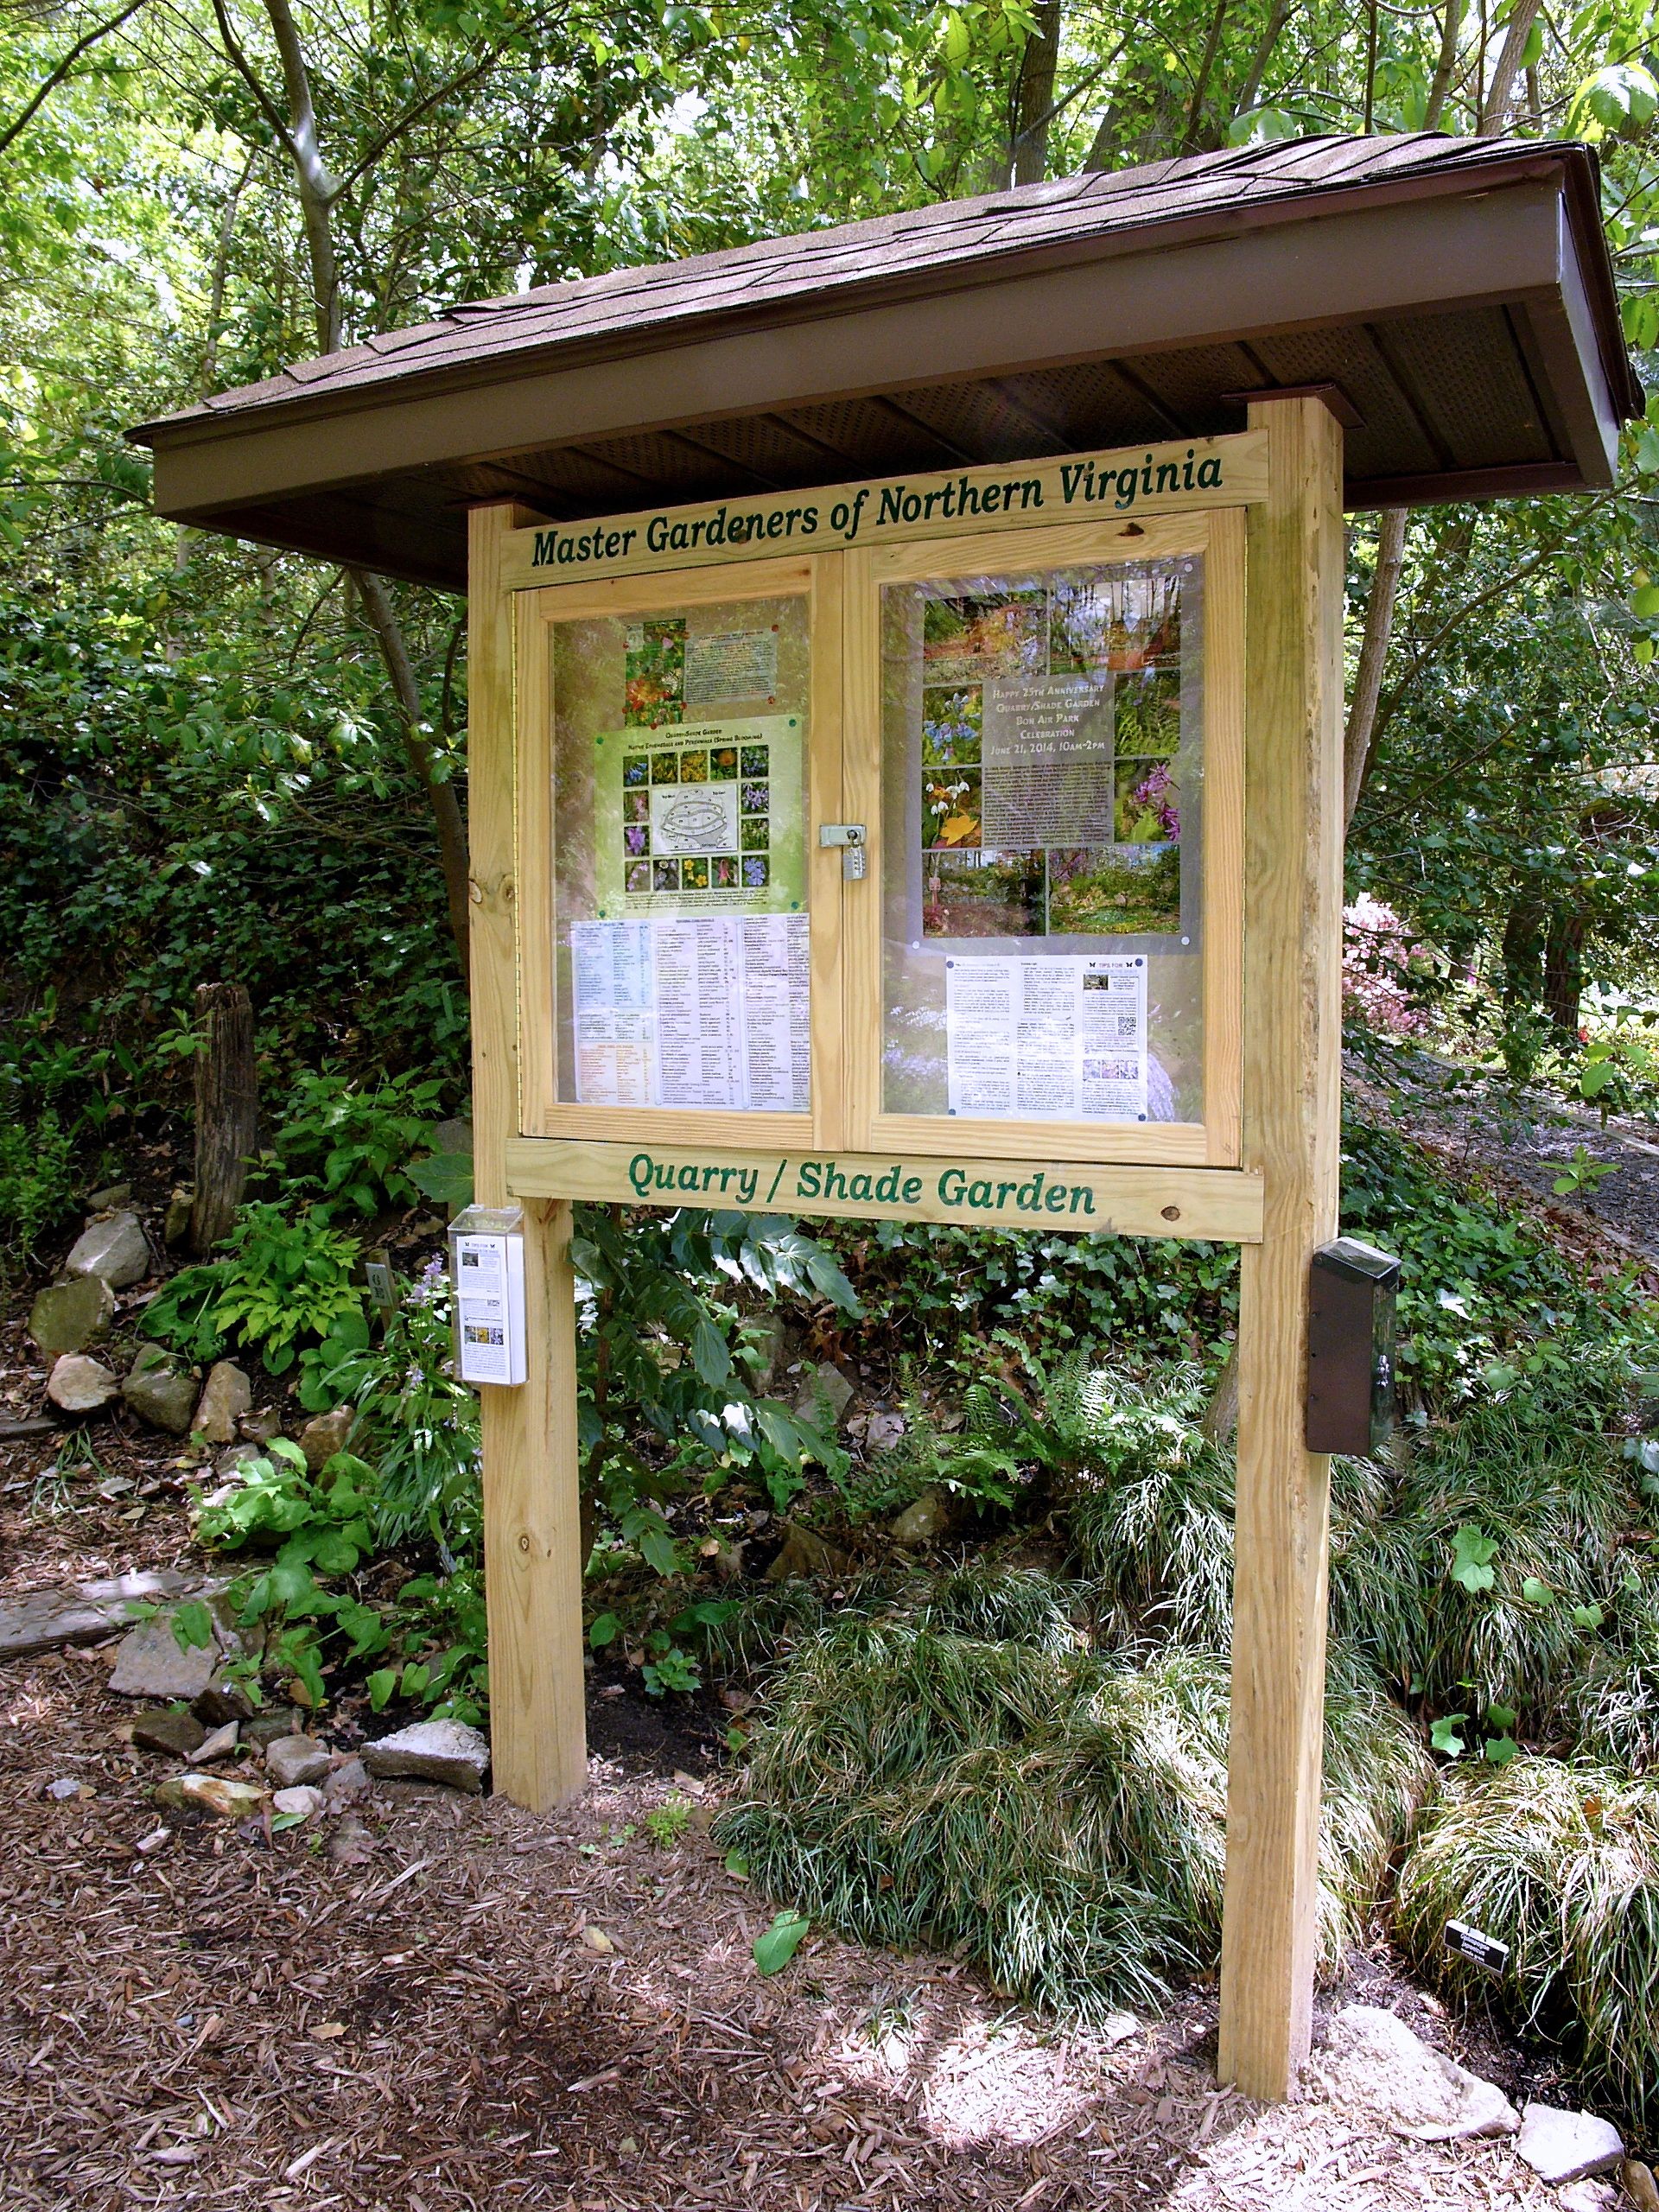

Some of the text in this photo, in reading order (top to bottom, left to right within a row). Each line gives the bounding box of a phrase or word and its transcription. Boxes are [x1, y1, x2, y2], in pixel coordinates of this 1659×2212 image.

[531, 448, 1224, 567] Master Gardeners of Northern Virginia
[1030, 742, 1057, 753] 2014,
[628, 1154, 760, 1204] Quarry
[797, 1161, 923, 1205] Shade
[938, 1168, 1096, 1215] Garden
